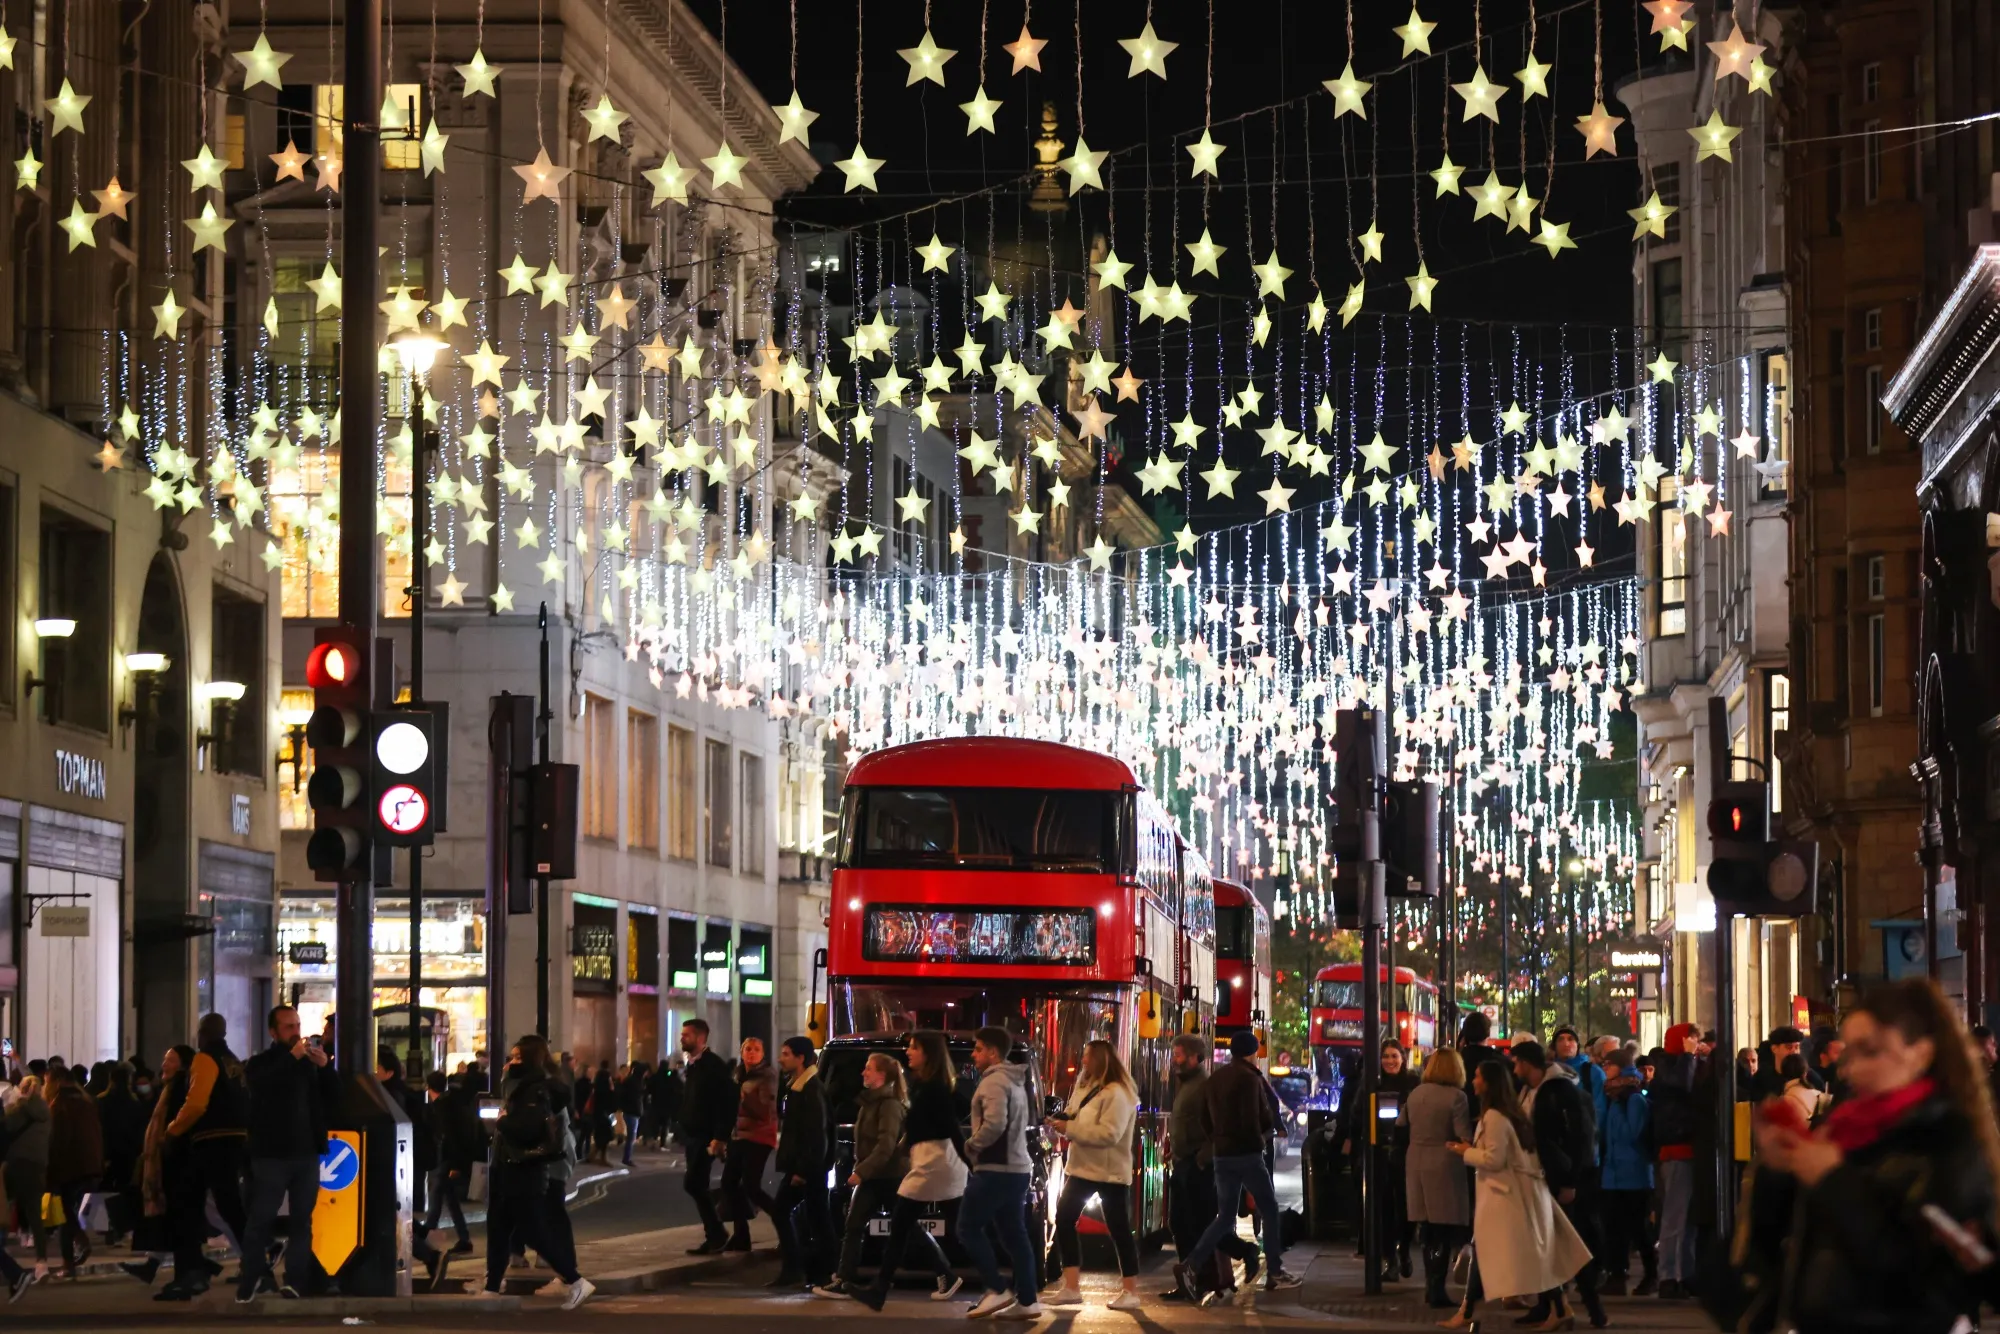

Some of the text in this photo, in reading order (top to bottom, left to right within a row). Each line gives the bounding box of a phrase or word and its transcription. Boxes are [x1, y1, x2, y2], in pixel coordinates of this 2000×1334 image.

[56, 749, 106, 799] TOPMAN
[231, 793, 250, 835] VANS
[294, 946, 325, 959] VANS
